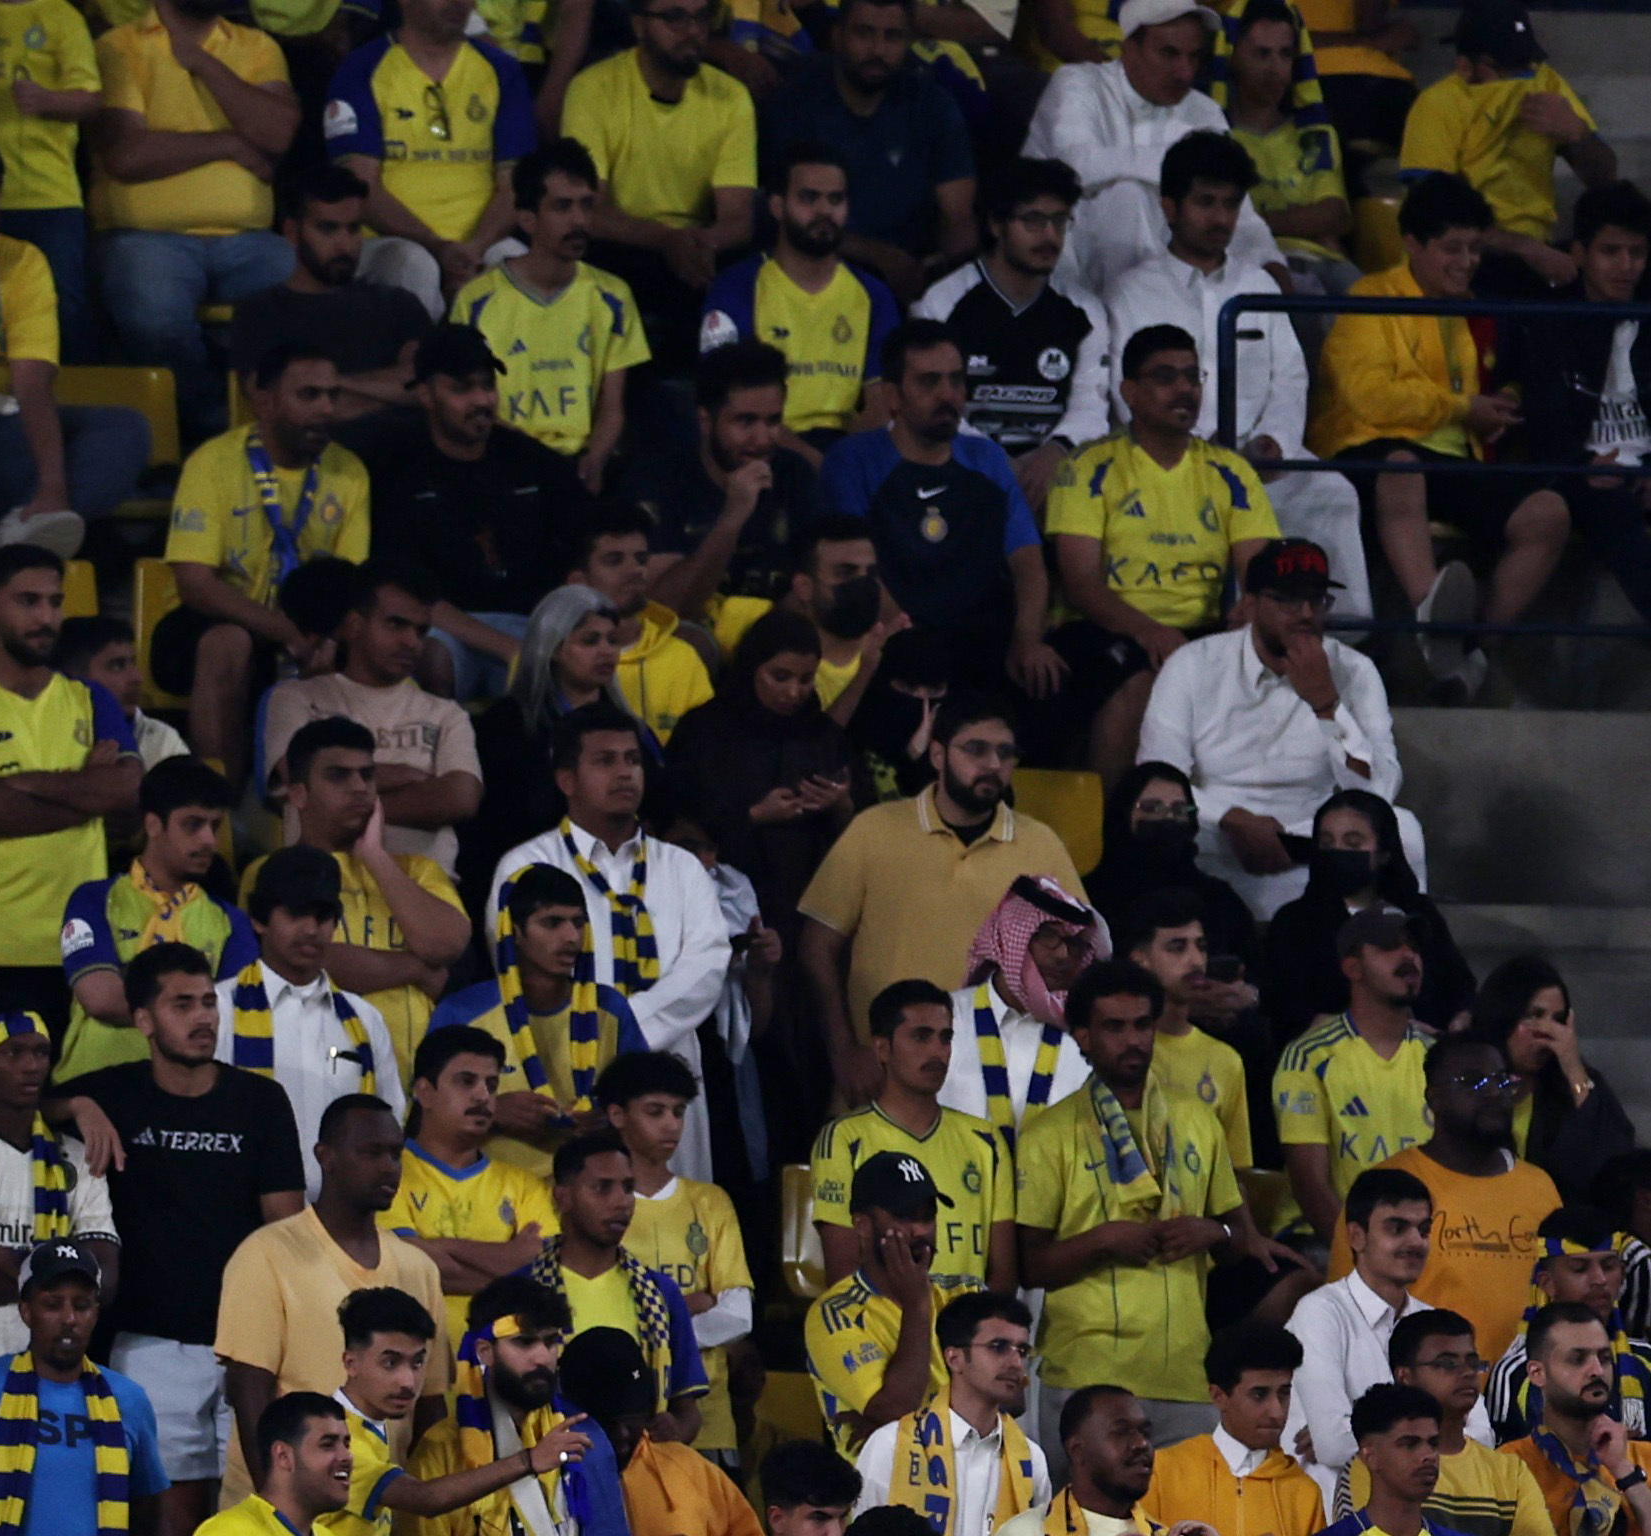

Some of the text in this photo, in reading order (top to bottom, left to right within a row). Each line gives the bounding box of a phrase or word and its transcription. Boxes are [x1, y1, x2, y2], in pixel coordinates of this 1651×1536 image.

[507, 387, 591, 422] KAF
[1100, 555, 1221, 588] KAFD
[156, 1131, 240, 1154] TERREX
